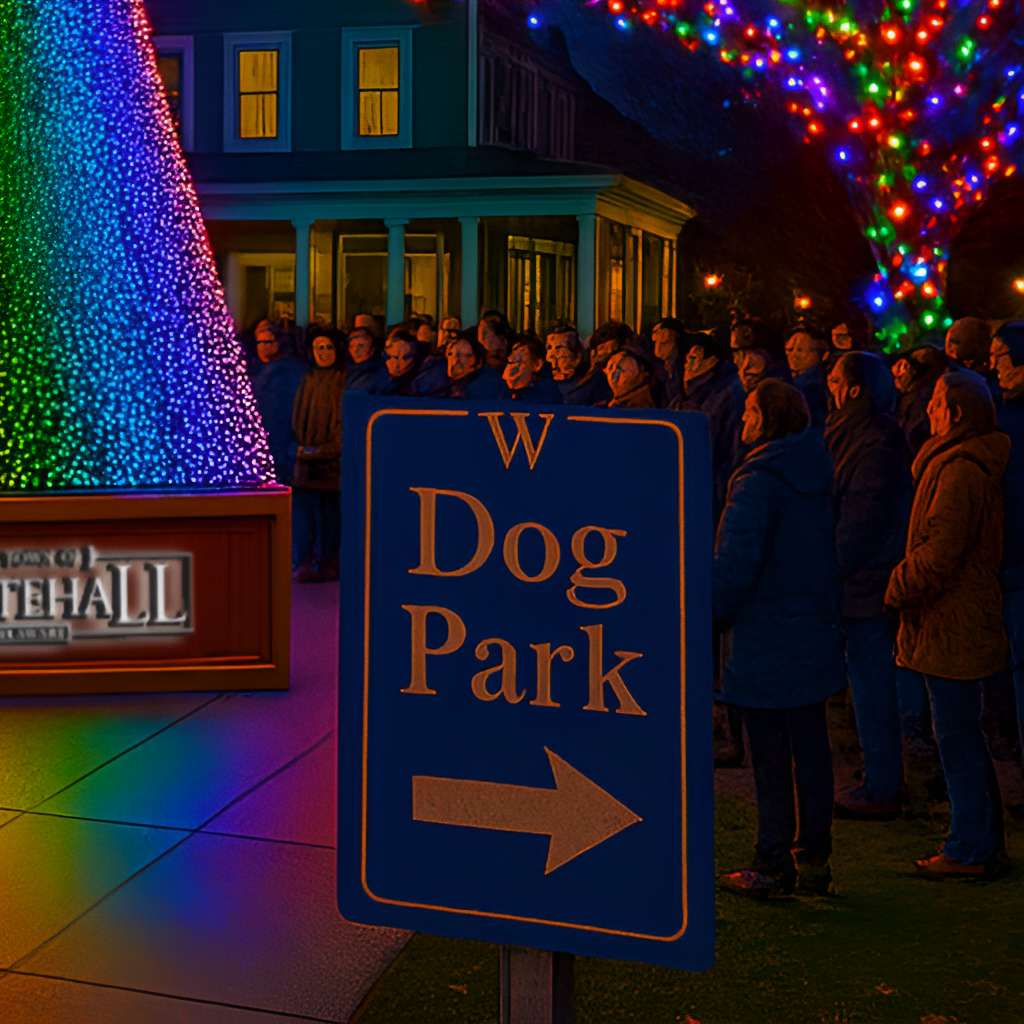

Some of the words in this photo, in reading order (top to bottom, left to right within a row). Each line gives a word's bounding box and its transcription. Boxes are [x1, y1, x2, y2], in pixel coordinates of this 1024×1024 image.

[478, 412, 554, 470] W
[408, 486, 628, 609] Dog
[400, 604, 648, 716] Park
